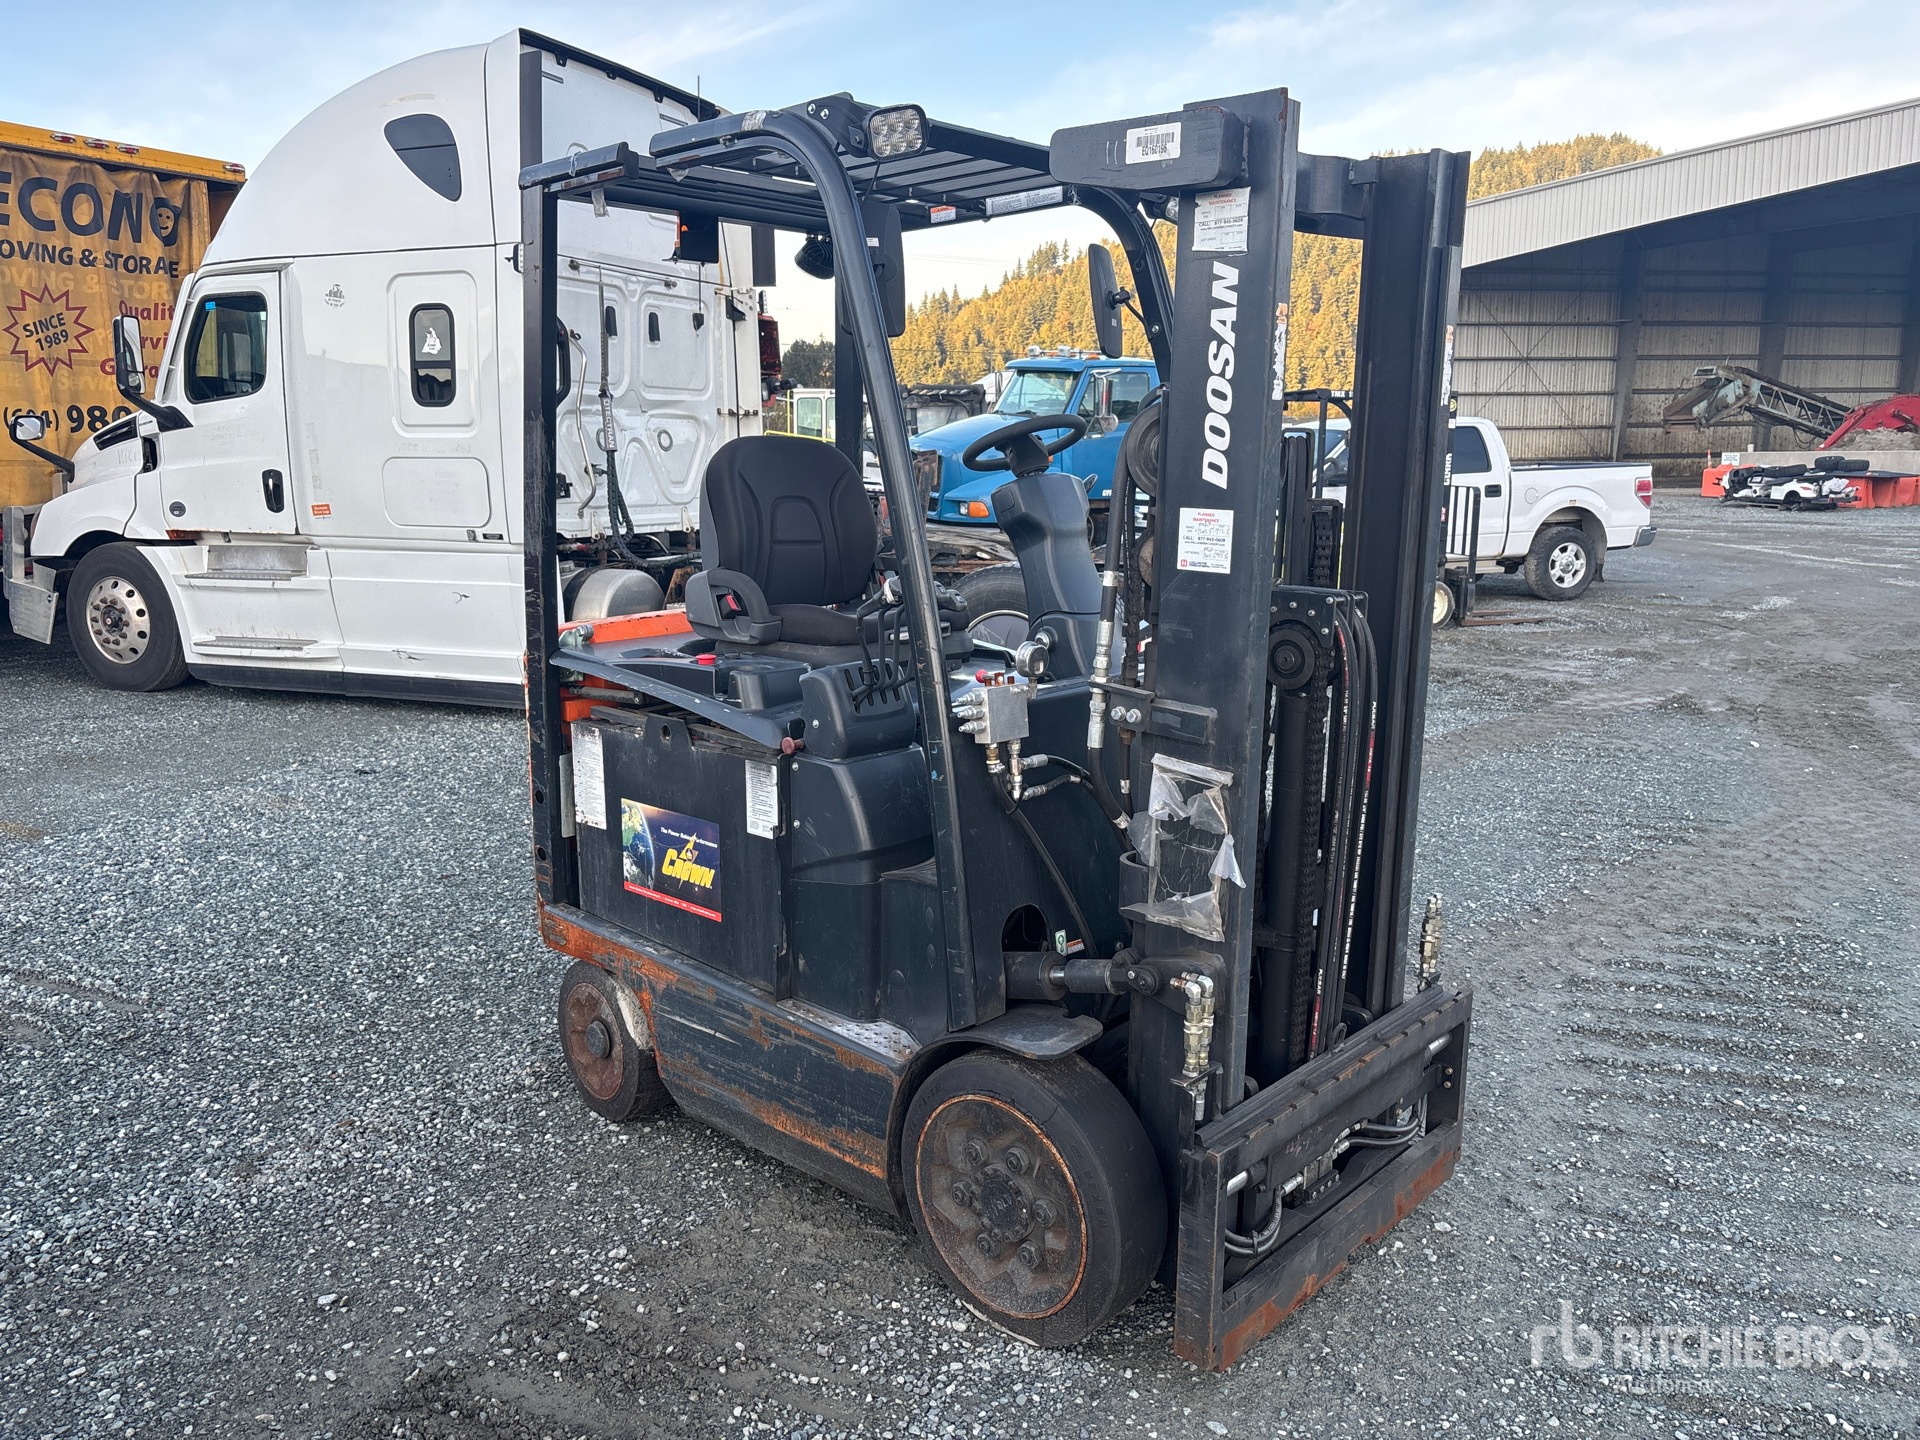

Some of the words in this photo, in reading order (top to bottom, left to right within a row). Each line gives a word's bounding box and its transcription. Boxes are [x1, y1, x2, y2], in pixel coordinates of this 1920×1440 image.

[79, 248, 98, 268] &
[22, 312, 66, 339] SINCE
[35, 329, 69, 351] 1989
[1201, 260, 1240, 490] DOOSAN
[1330, 390, 1346, 398] TMX
[661, 848, 716, 889] CROWN
